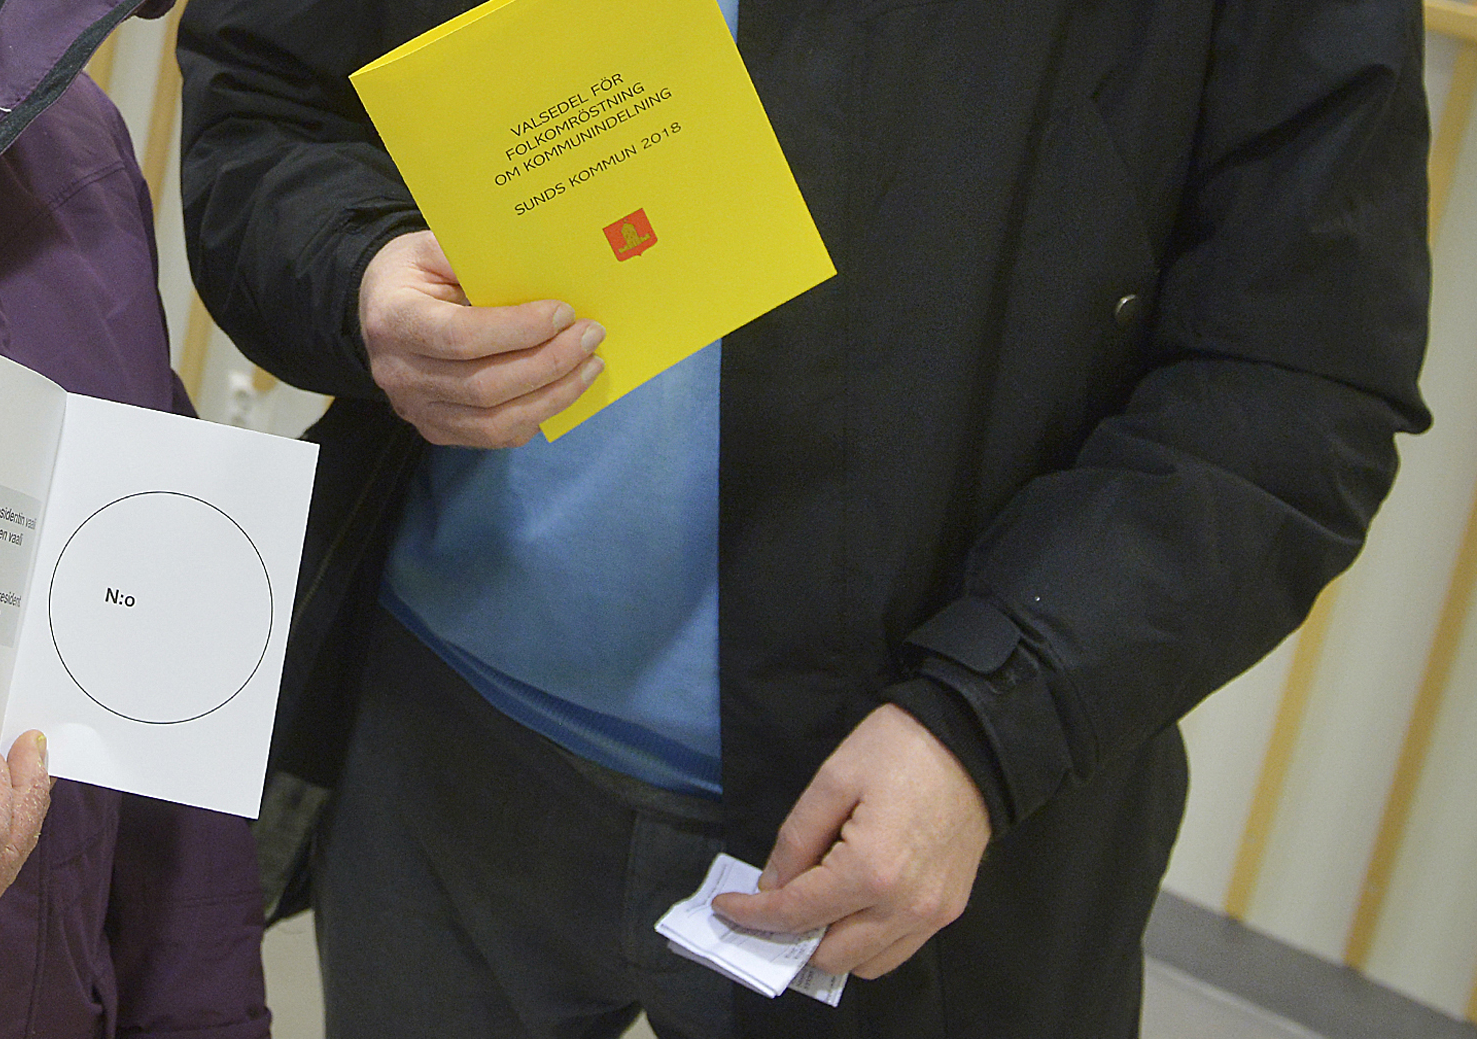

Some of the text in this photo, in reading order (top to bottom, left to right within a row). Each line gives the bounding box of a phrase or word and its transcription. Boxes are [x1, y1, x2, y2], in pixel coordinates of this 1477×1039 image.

[494, 87, 672, 186] OM KOMMUNINDELNING
[505, 81, 645, 161] FOLKOMRÖSTNING
[510, 72, 624, 137] VALSEDEL FÖR
[514, 121, 682, 216] SUNDS KOMMUN 2018
[8, 531, 23, 546] vaali
[105, 587, 136, 607] N:o
